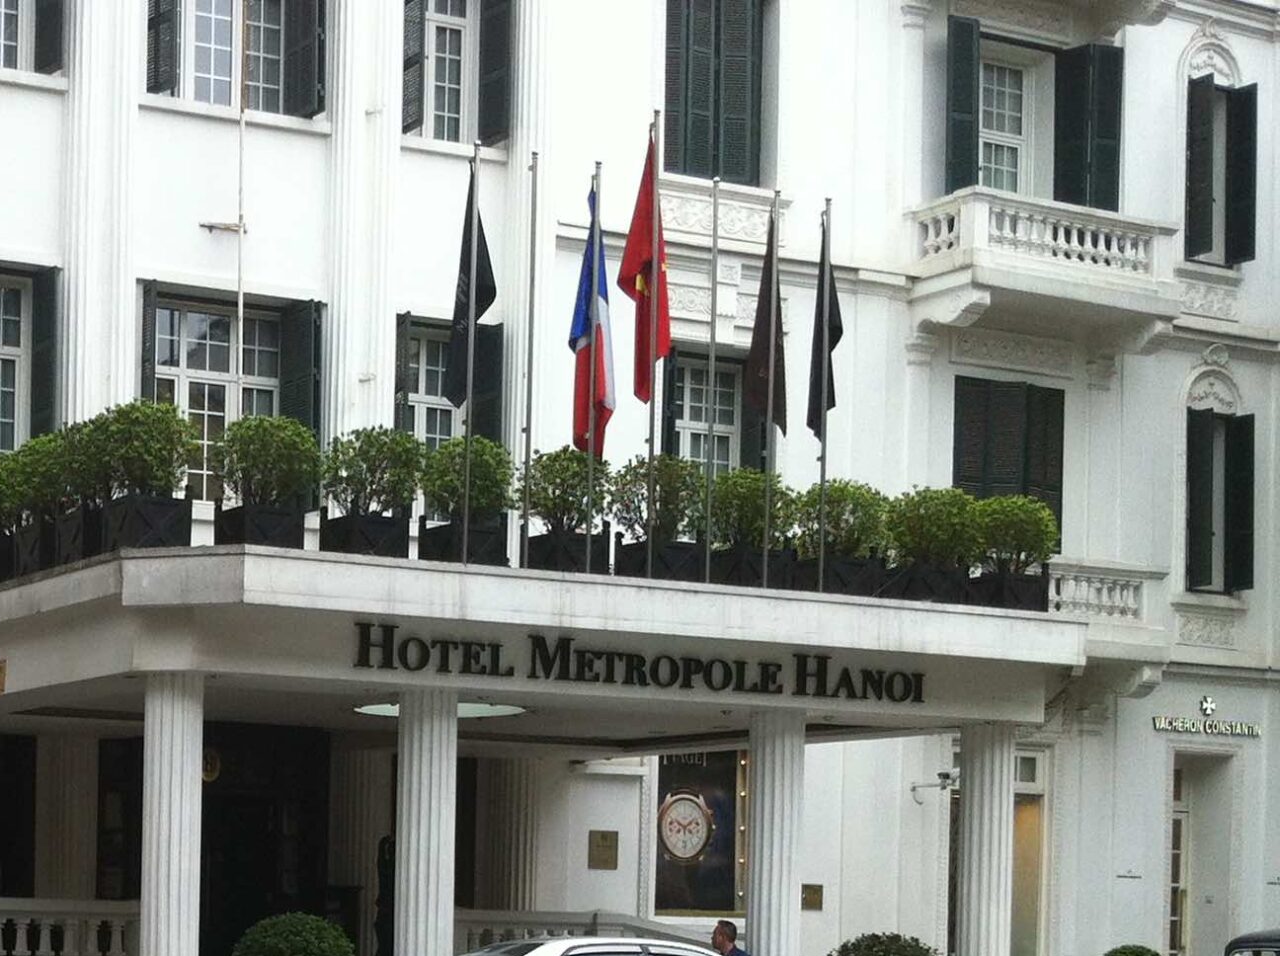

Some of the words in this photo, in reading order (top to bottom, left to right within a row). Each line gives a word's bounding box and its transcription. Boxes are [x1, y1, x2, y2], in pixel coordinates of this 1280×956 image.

[353, 621, 515, 678] HOTEL
[526, 633, 784, 695] METROPOLE
[791, 652, 926, 704] HANOI
[1152, 716, 1202, 734] VACHERON
[1203, 719, 1262, 738] CONSTANTIN
